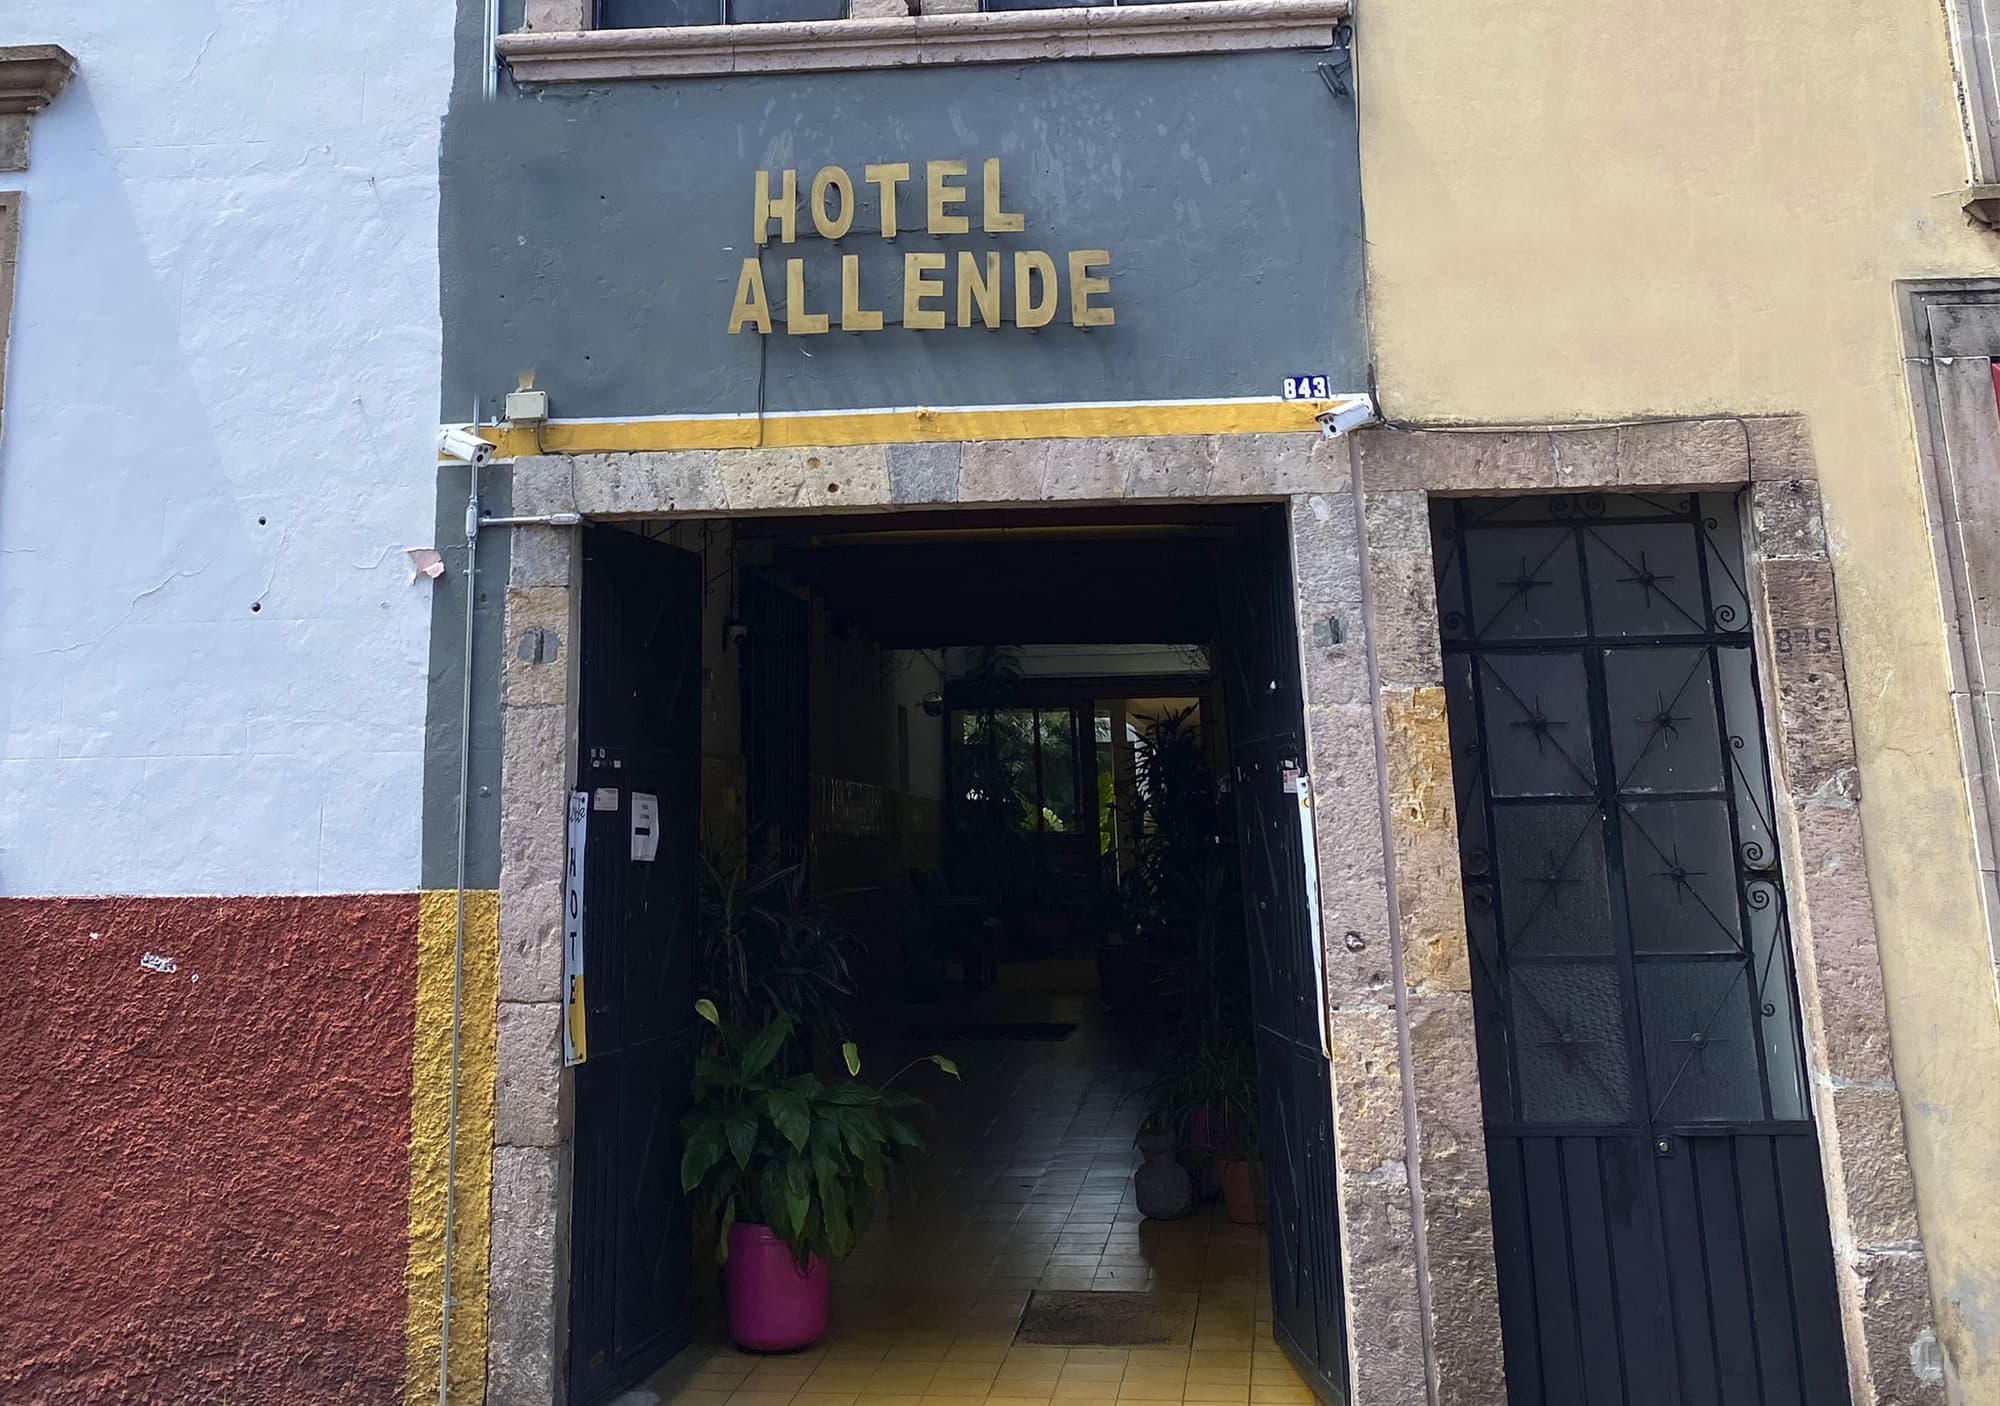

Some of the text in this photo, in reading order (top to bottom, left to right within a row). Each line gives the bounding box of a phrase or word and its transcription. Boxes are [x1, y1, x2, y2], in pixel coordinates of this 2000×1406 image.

[753, 157, 1025, 244] HOTEL
[727, 249, 1115, 335] ALLENDE
[1283, 376, 1326, 399] 843
[568, 847, 579, 1048] HOTEL
